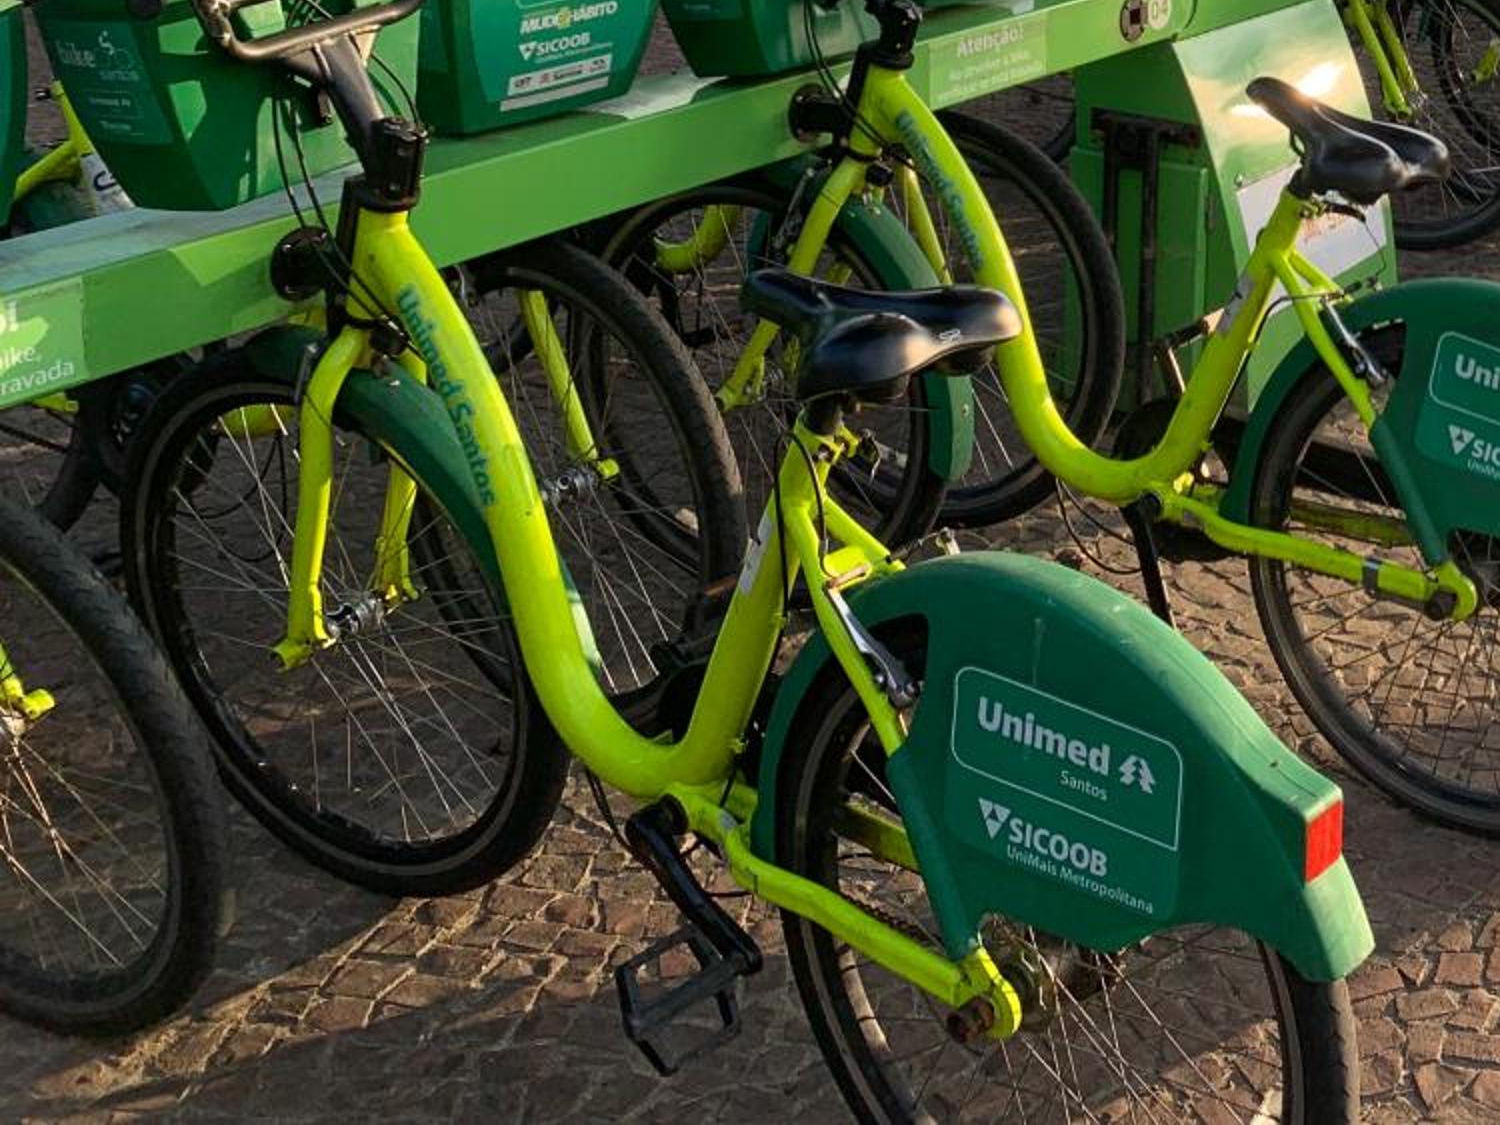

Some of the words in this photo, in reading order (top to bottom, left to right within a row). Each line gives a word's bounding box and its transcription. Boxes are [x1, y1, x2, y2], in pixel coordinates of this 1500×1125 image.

[536, 32, 591, 56] SICOOB
[957, 22, 1025, 59] Atenção!
[398, 284, 464, 402] Unimed
[449, 402, 495, 507] Santos
[977, 696, 1110, 776] Unimed
[1060, 770, 1108, 801] Santos
[1009, 818, 1108, 877] SICOOB
[1007, 847, 1057, 877] UniMais
[1060, 866, 1153, 914] Metropolitana
